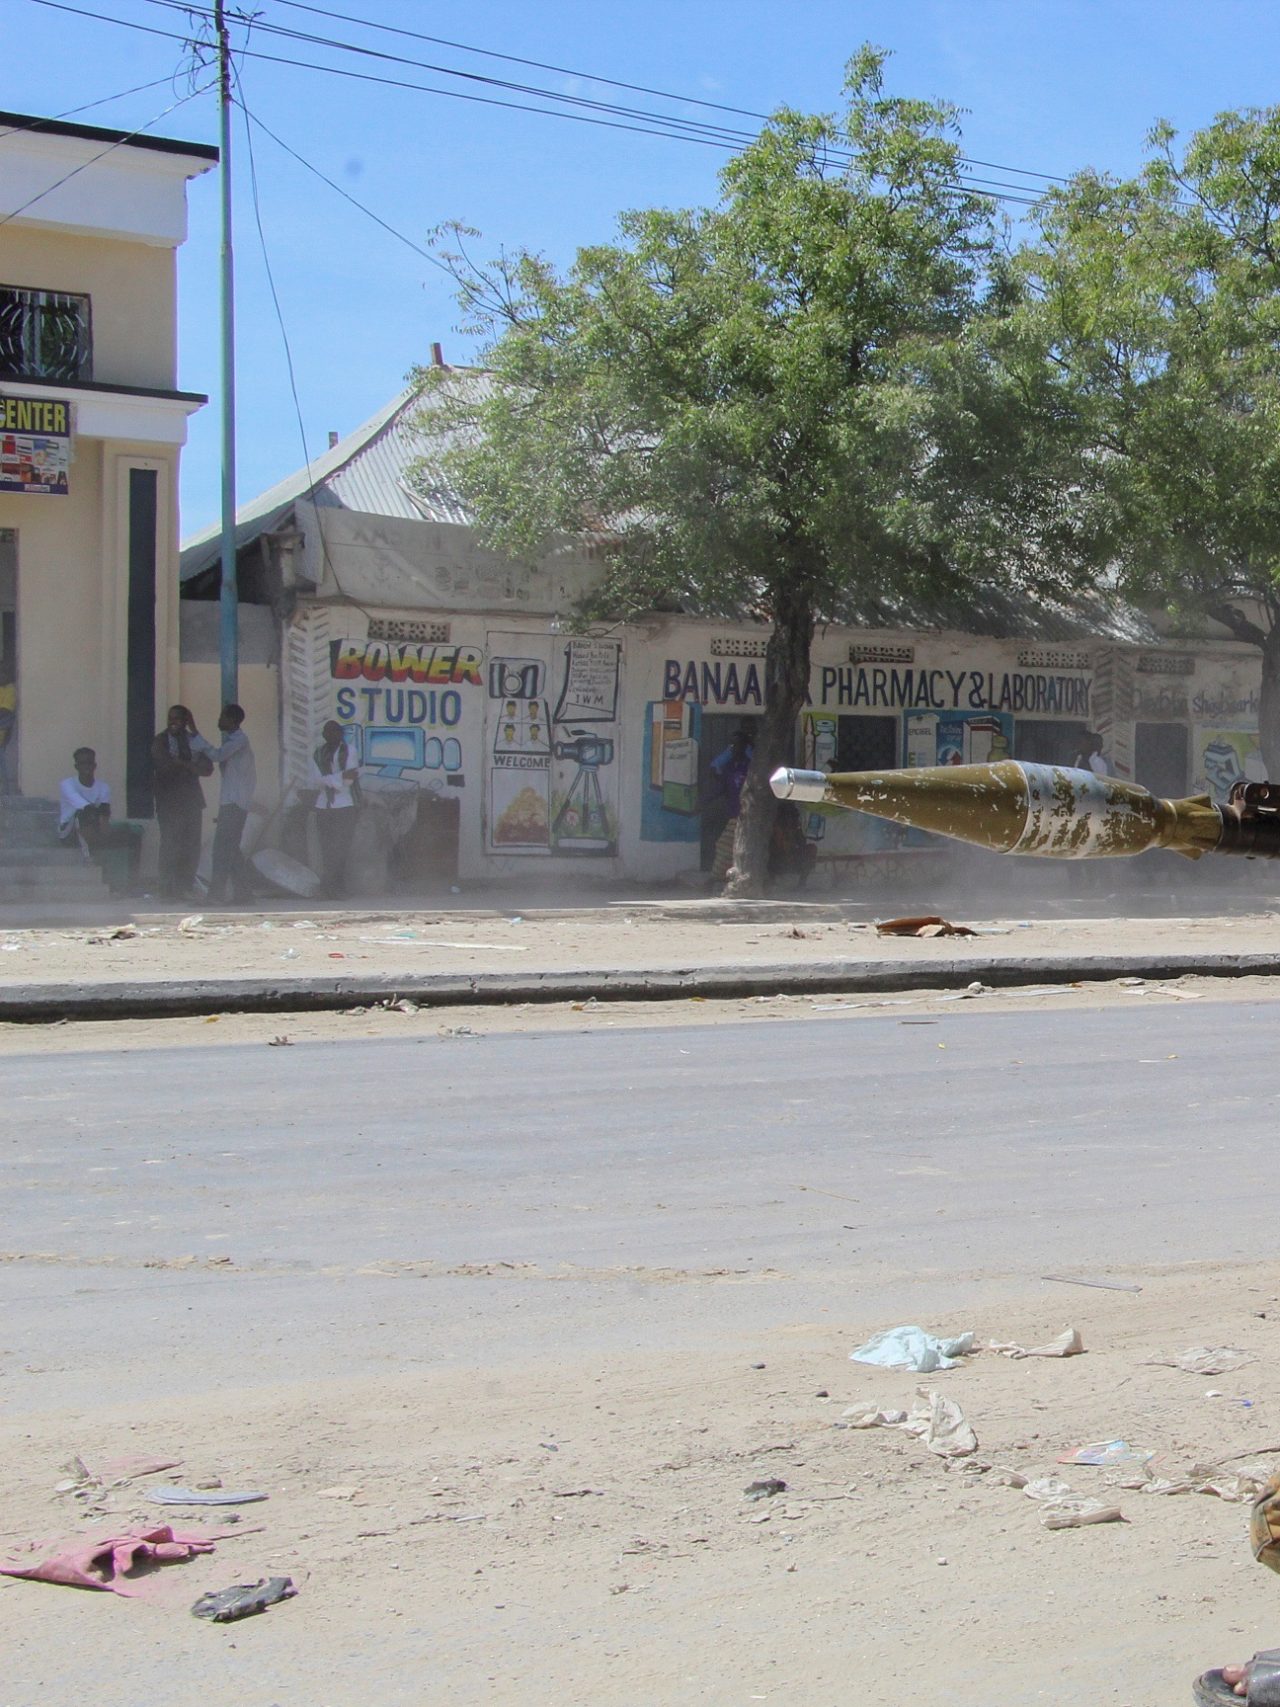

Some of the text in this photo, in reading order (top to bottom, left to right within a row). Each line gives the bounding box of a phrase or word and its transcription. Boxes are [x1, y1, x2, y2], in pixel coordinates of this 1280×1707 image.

[330, 638, 484, 686] BOWER
[336, 687, 462, 726] STUDIO
[493, 755, 551, 768] WELCOME
